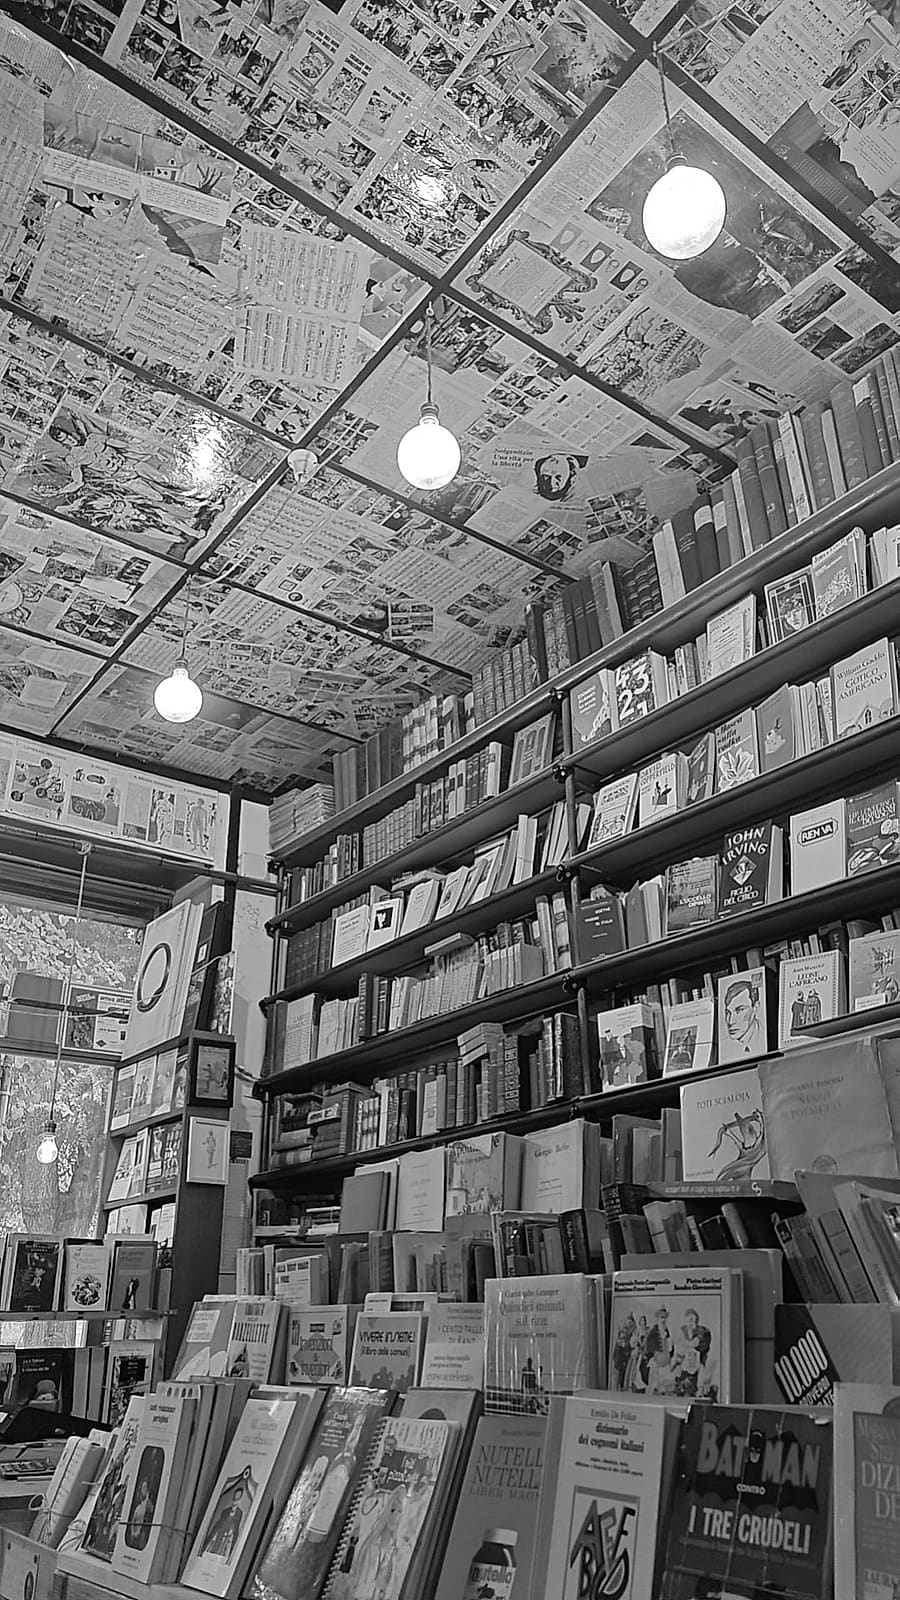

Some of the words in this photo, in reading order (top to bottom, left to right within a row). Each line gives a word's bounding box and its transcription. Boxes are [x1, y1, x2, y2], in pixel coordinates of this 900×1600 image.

[837, 664, 861, 680] William
[845, 667, 879, 689] GOTICO
[838, 671, 888, 701] AMERICANO
[618, 689, 634, 721] 2
[640, 762, 662, 779] DAVID
[821, 823, 833, 835] VA
[727, 827, 765, 849] JOHN
[722, 841, 769, 866] IRVING
[737, 890, 759, 903] CIRCO
[714, 1091, 751, 1105] SCIALOJA
[536, 1299, 565, 1312] minuti
[360, 1331, 384, 1343] VIVERE
[464, 1325, 485, 1334] TALLE
[596, 1421, 629, 1436] dizionario
[578, 1433, 589, 1446] dei
[590, 1438, 618, 1449] cognomi
[620, 1438, 645, 1453] italiani
[736, 1483, 767, 1496] CONTRO
[688, 1505, 697, 1533] I
[703, 1507, 734, 1540] TRE
[738, 1513, 812, 1555] CRUDELI
